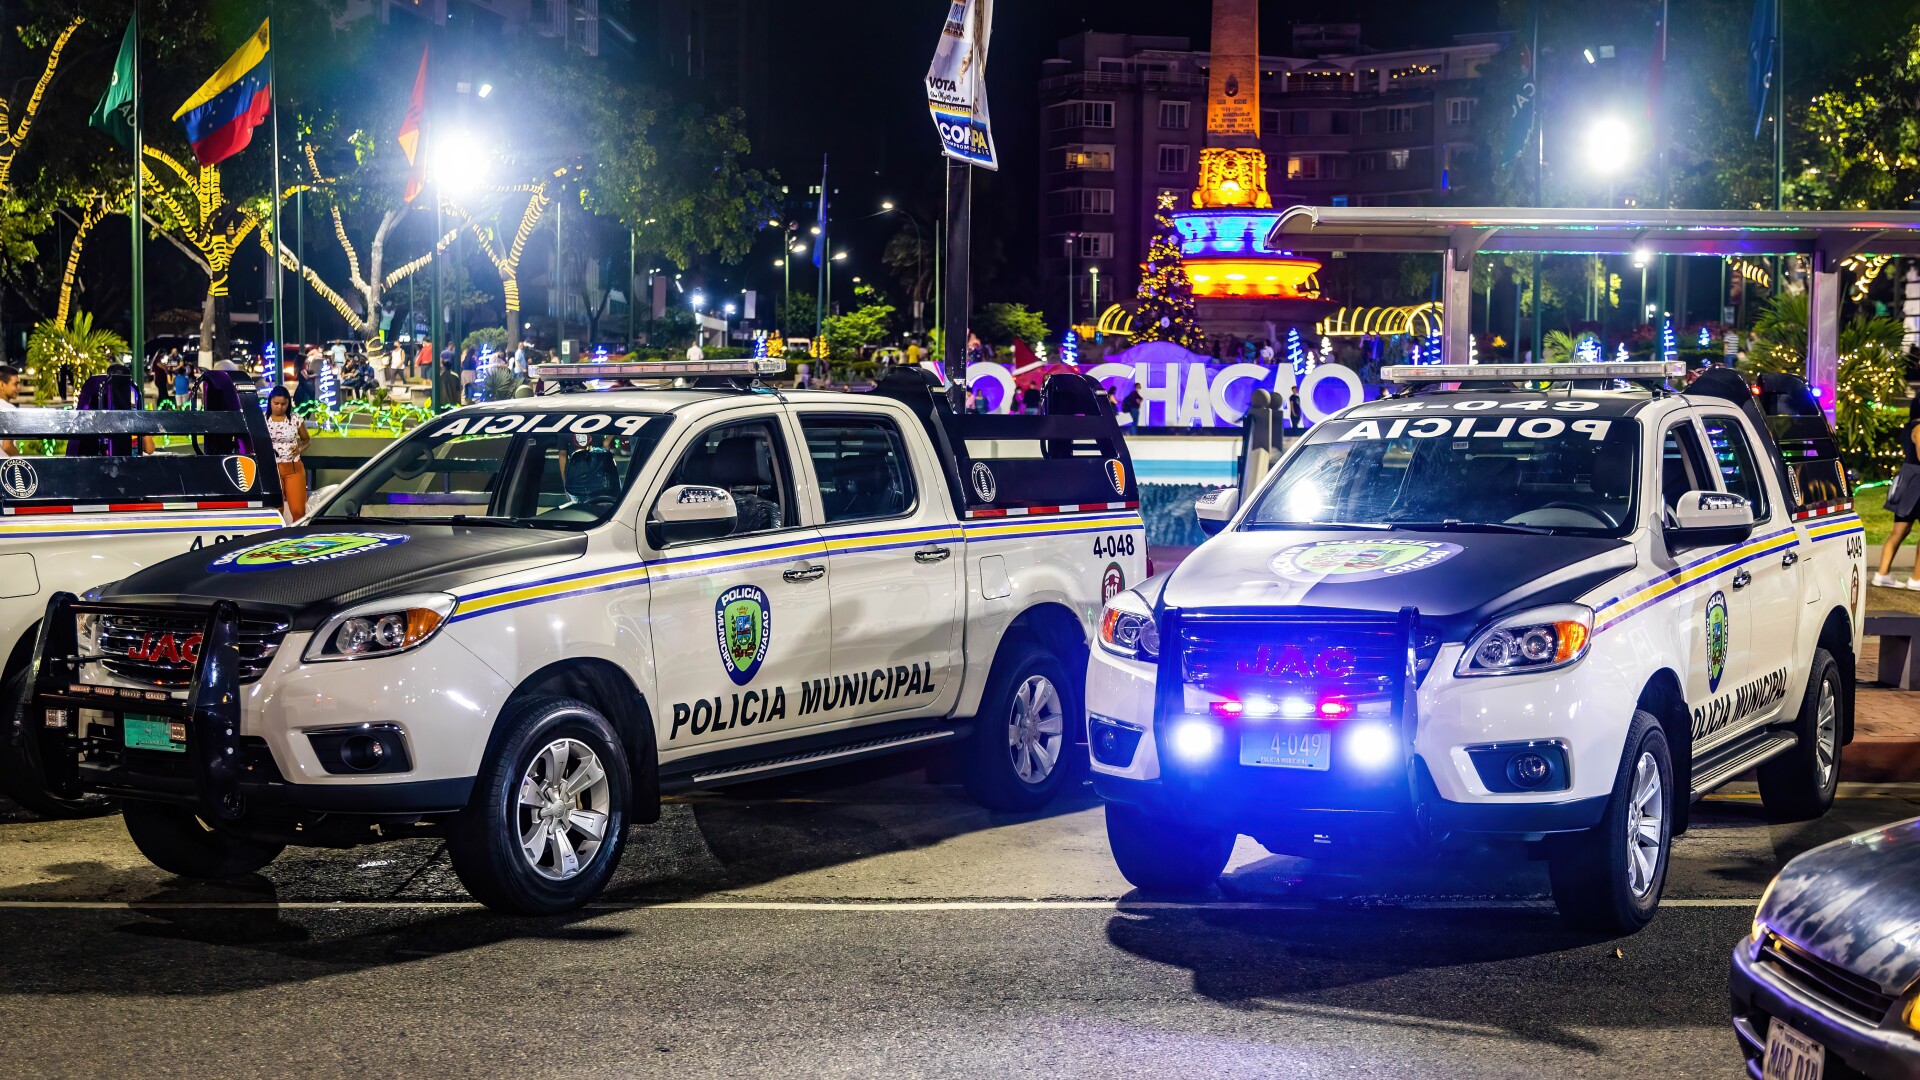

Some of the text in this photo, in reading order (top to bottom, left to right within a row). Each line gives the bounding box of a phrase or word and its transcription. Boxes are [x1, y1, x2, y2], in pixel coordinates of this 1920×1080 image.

[929, 77, 956, 92] VOTA
[1086, 363, 1365, 428] CHACAO
[291, 542, 389, 565] CHACAO
[1093, 534, 1135, 558] 4-048
[1384, 550, 1450, 574] CHACAO
[128, 632, 203, 663] JAC
[717, 610, 735, 672] MUNICIPIO
[757, 610, 769, 662] CHACAO
[1237, 644, 1356, 678] JAC
[669, 661, 935, 740] POLICIA MUNICIPAL
[1692, 667, 1787, 740] OLICIA MUNICIPAL
[1271, 733, 1321, 757] 4-049
